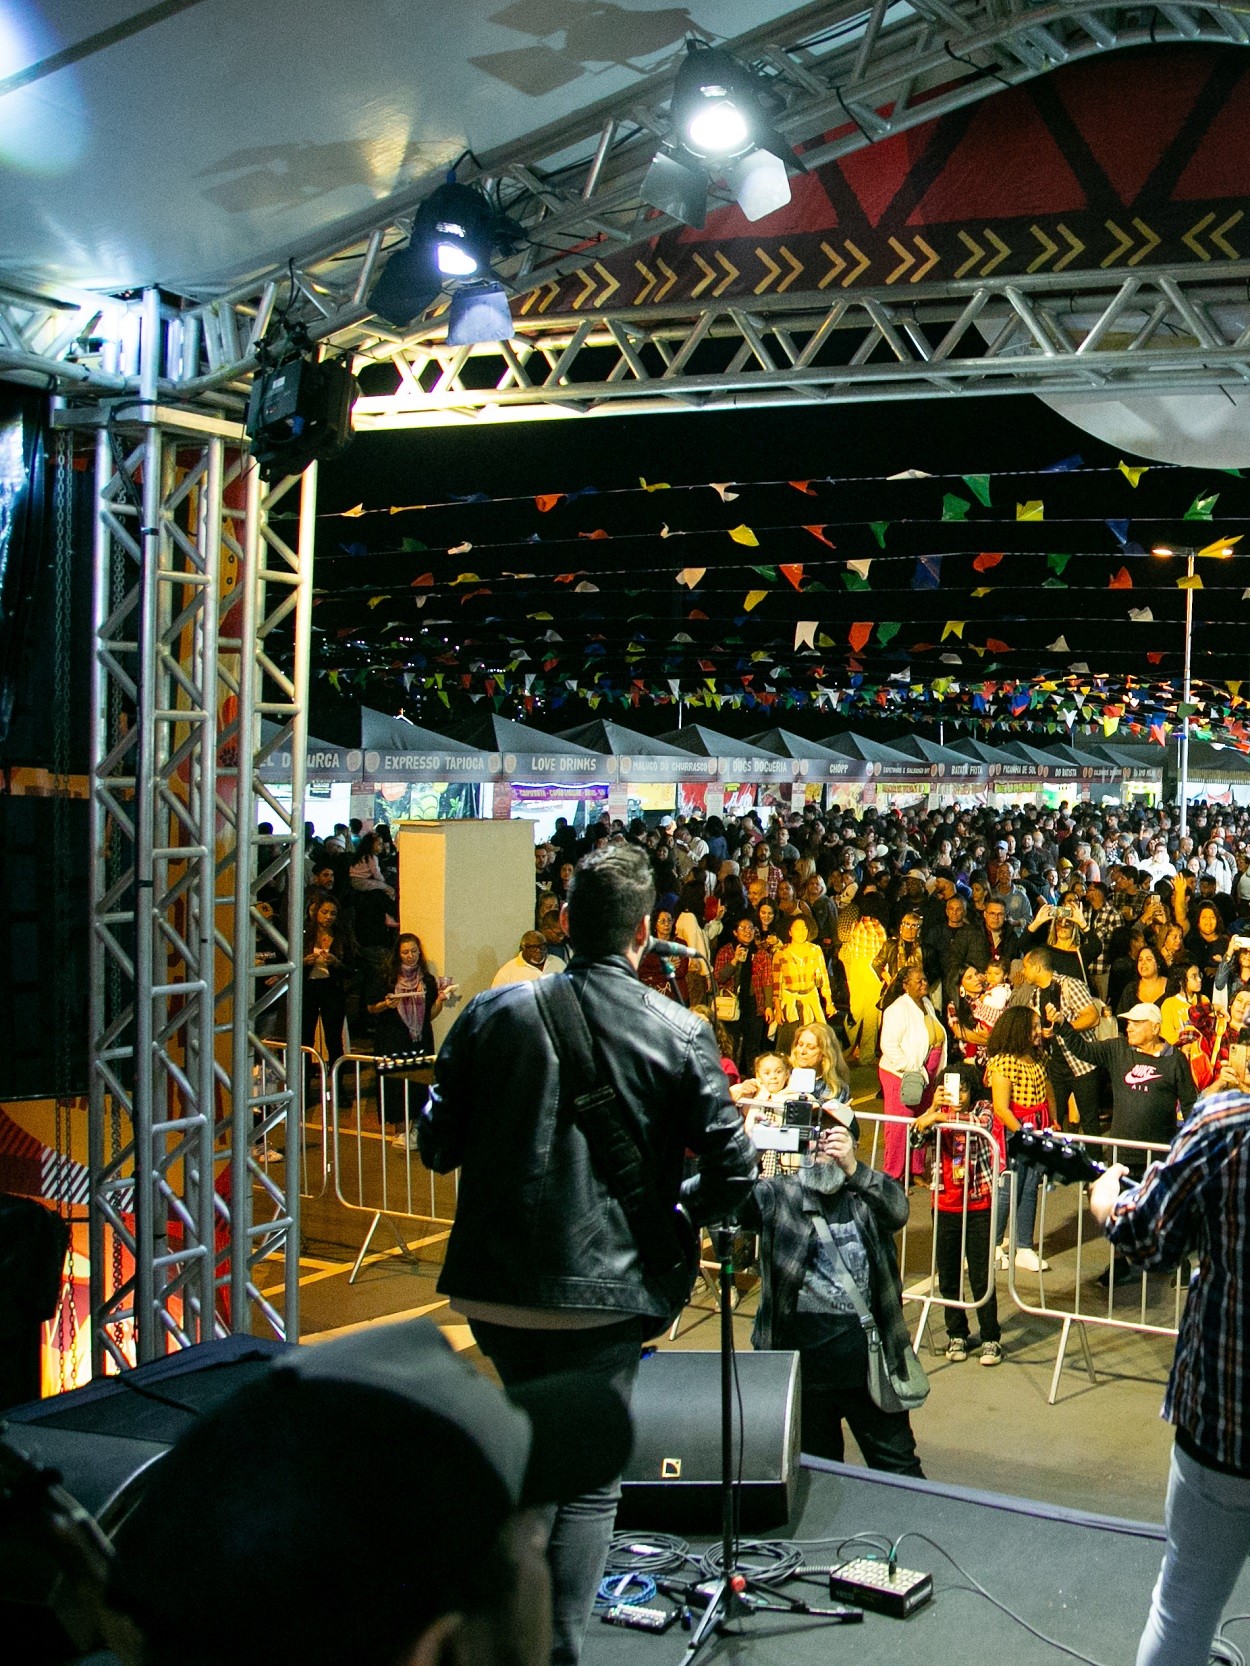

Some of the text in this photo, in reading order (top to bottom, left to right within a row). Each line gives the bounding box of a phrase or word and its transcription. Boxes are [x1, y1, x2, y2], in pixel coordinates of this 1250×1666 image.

[384, 755, 485, 770] EXPRESSO TAPIOCA
[531, 757, 597, 771] LOVE DRINKS
[660, 762, 669, 772] DO
[671, 762, 708, 772] CHURRASCO
[732, 760, 751, 773] DOGS
[829, 763, 849, 774] CHOPP
[1131, 1064, 1157, 1078] NIKE
[1131, 1083, 1149, 1092] AIR
